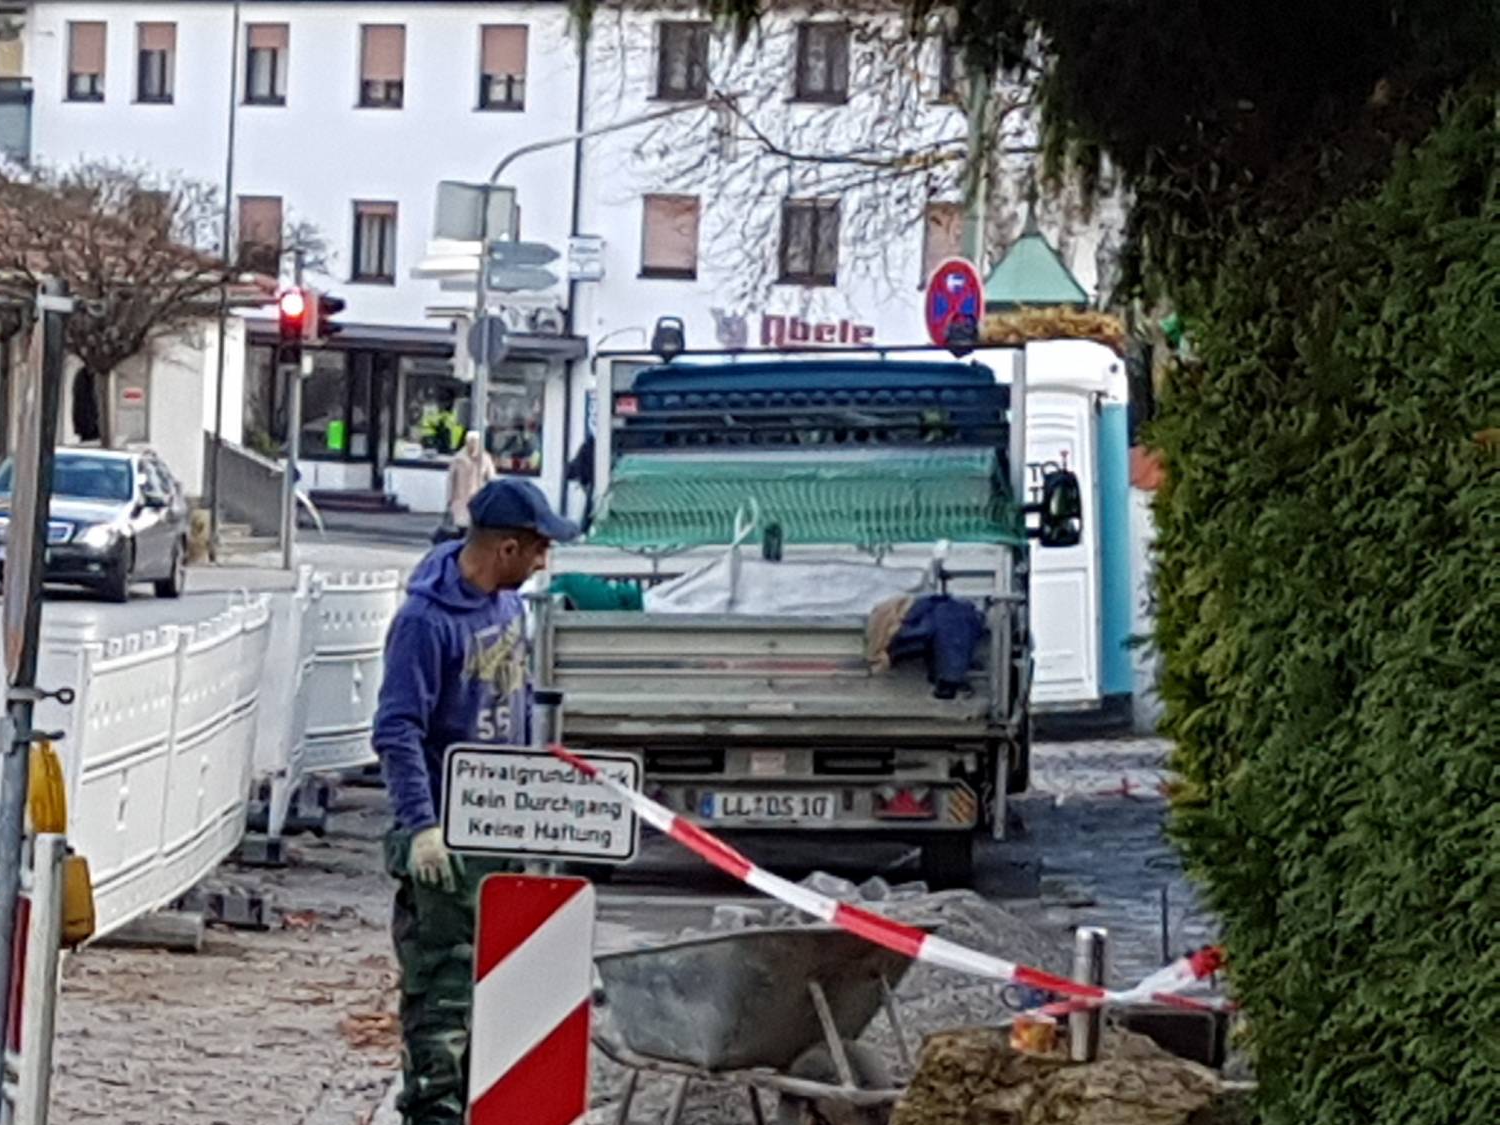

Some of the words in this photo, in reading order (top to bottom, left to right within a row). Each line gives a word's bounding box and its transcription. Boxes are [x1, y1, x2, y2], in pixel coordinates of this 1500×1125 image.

[461, 790, 505, 808] Kein
[514, 792, 622, 820] Durchgang
[468, 818, 524, 838] Keine
[534, 822, 612, 848] Haftung
